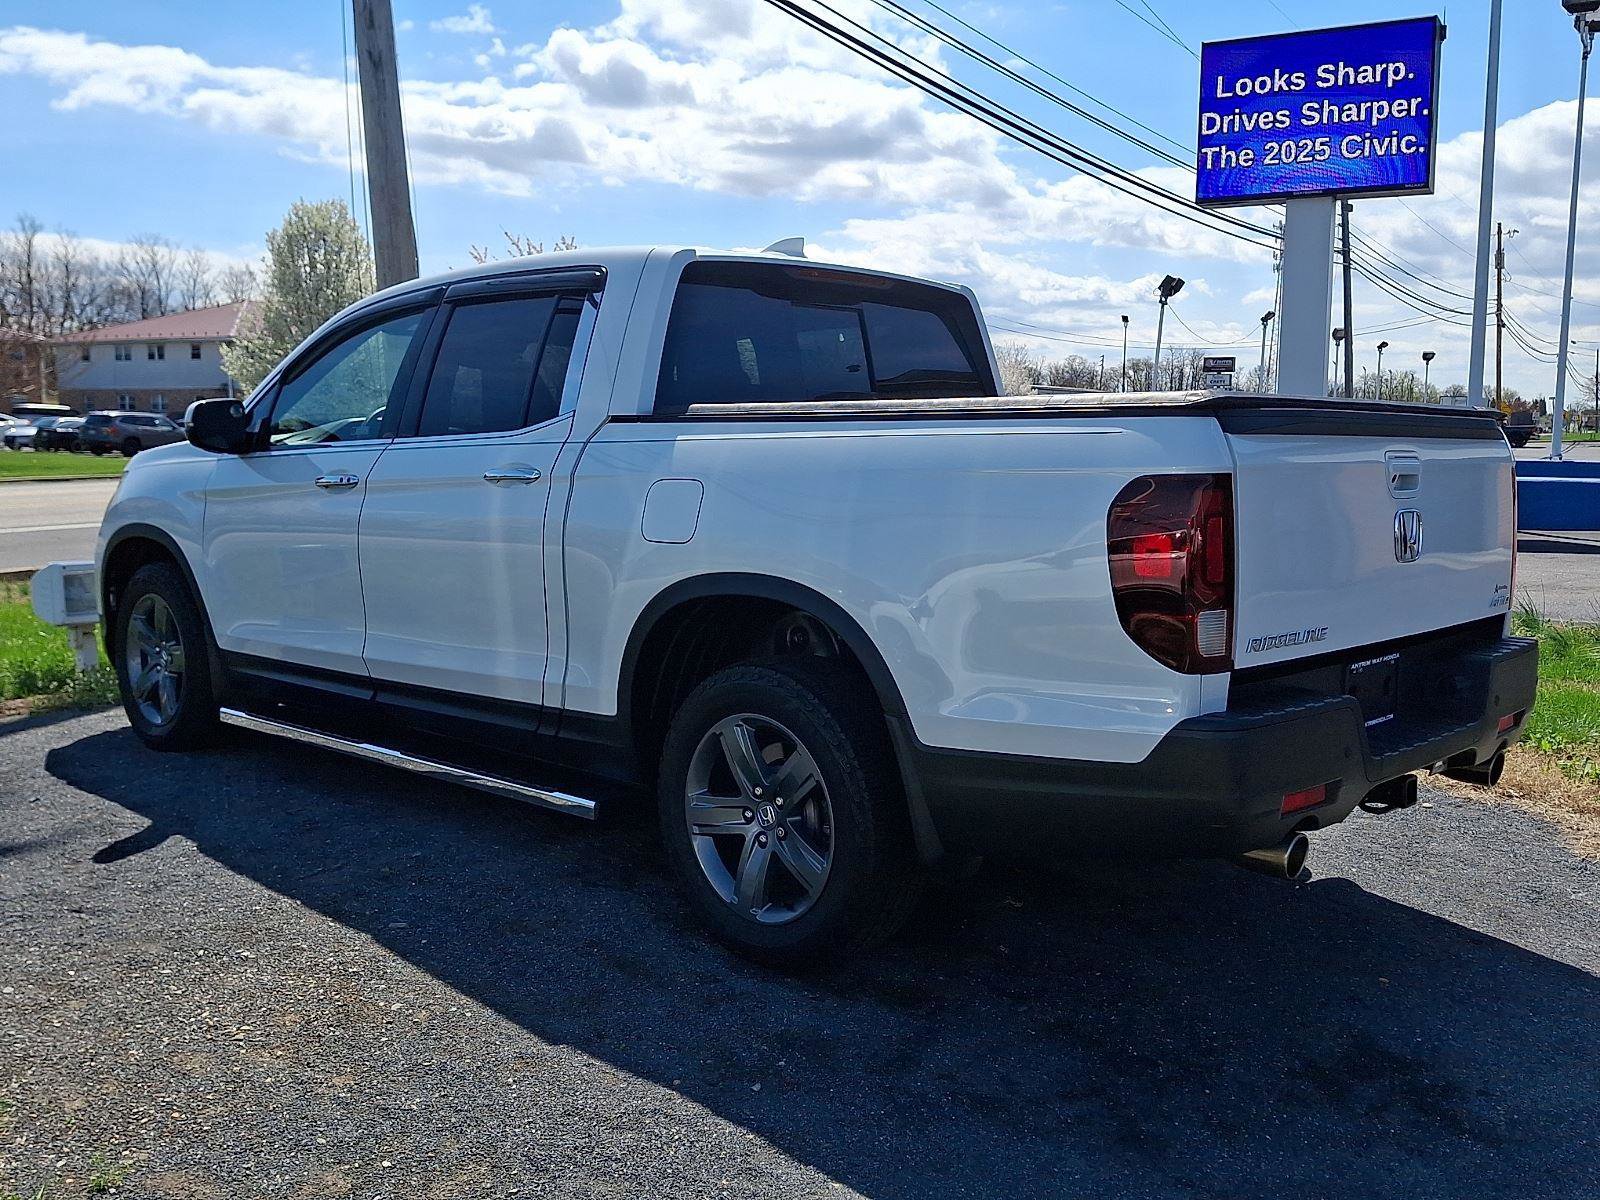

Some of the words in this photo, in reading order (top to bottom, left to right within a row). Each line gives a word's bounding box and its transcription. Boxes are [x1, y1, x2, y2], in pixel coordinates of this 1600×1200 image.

[1216, 68, 1306, 98] Looks
[1315, 61, 1415, 88] Sharp.
[1201, 108, 1291, 136] Drives
[1301, 97, 1430, 126] Sharper.
[1201, 146, 1255, 170] The
[1263, 137, 1331, 165] 2025
[1341, 130, 1425, 159] Civic.
[1245, 626, 1329, 653] RIDGELINE
